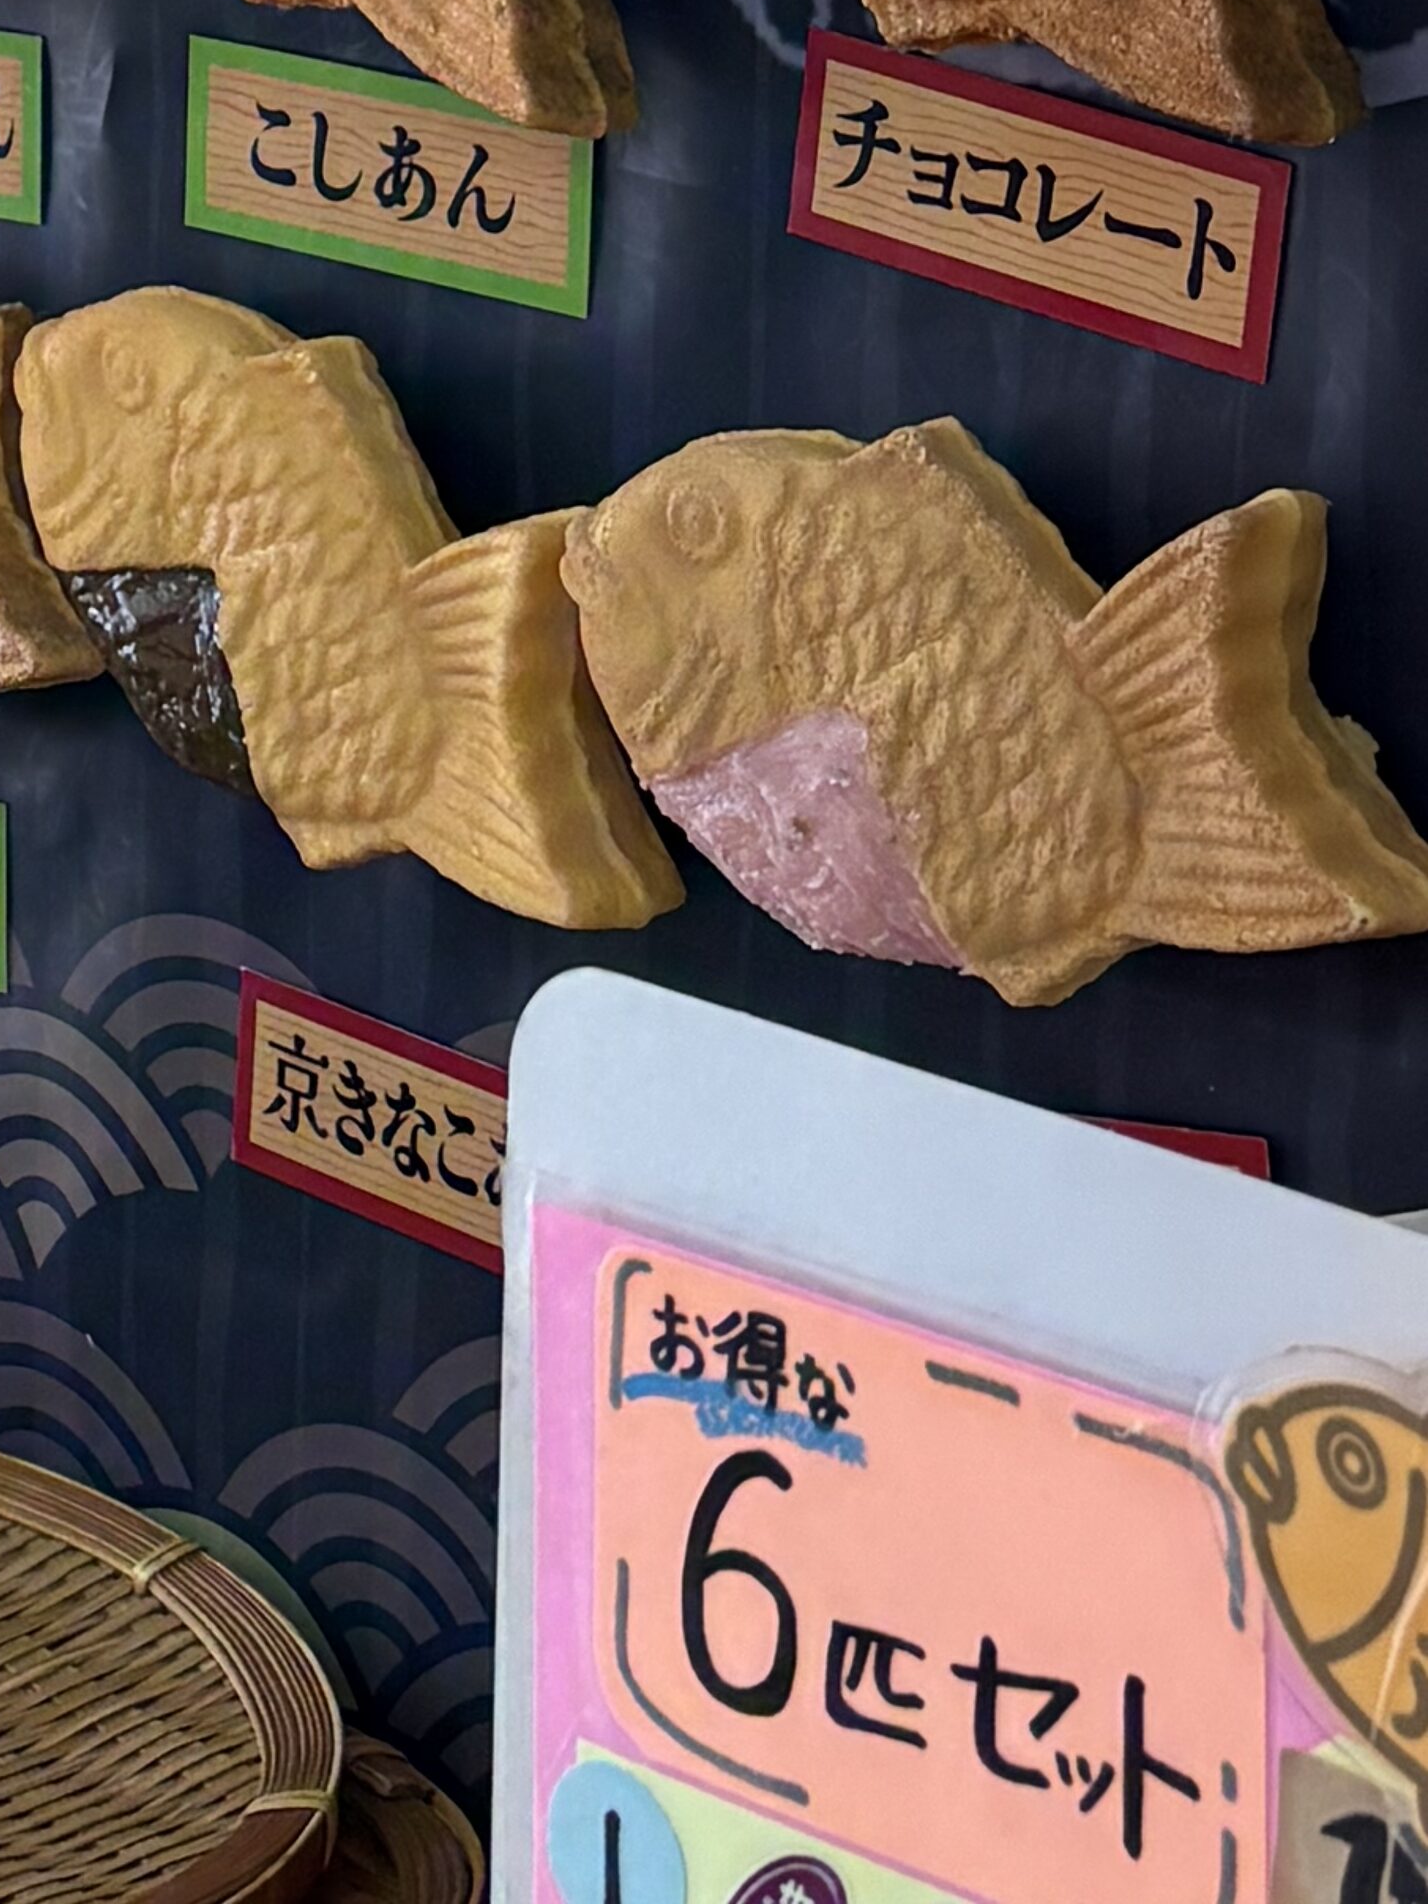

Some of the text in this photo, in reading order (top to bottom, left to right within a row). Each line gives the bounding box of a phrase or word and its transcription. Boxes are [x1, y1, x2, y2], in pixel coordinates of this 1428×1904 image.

[251, 101, 515, 235] こしあん
[832, 100, 1236, 300] チョコレート
[647, 1294, 857, 1426] お得な
